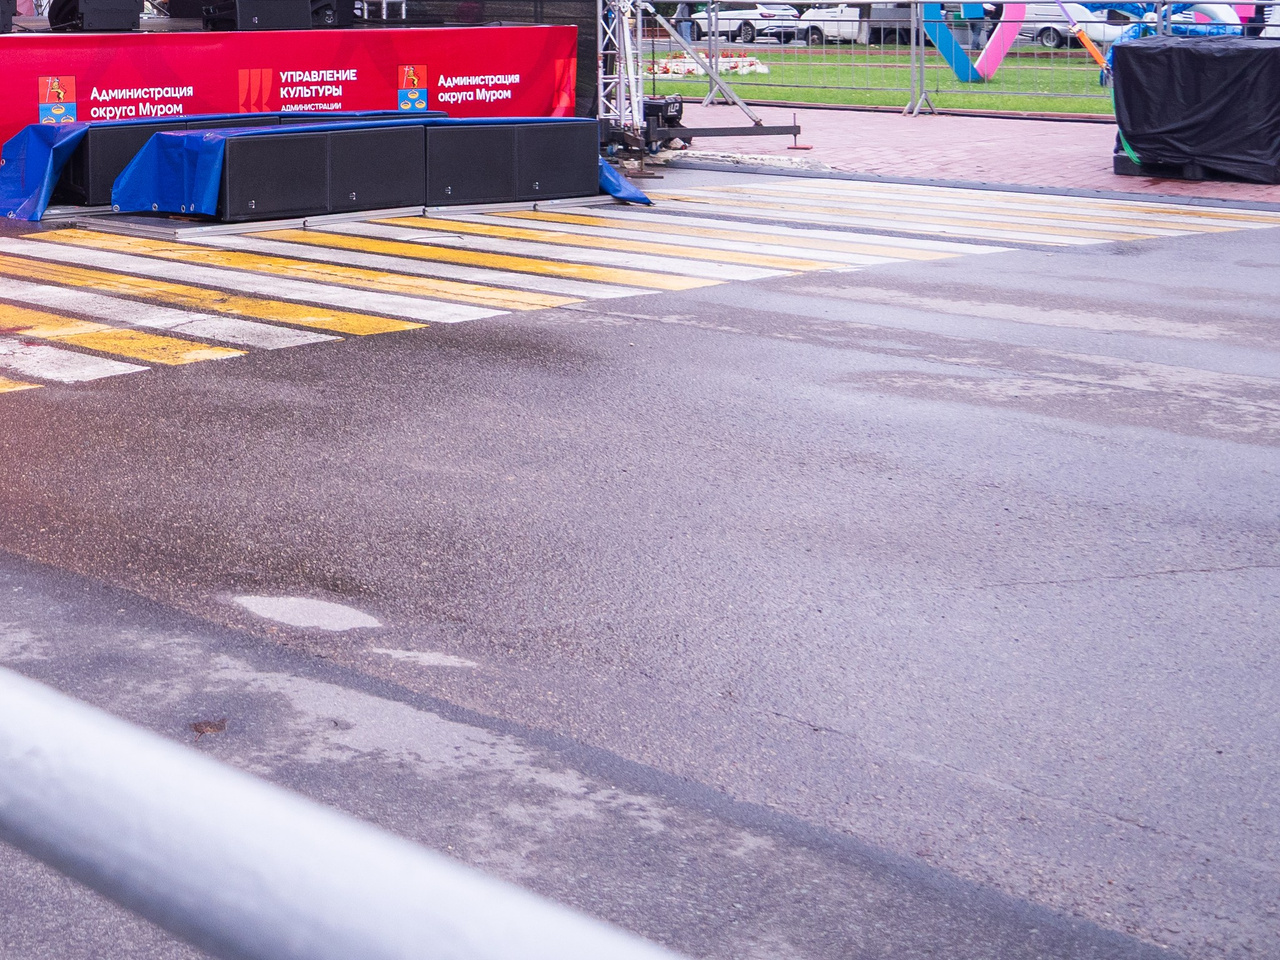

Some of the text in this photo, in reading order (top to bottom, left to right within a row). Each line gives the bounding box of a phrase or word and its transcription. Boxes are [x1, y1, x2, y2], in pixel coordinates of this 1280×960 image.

[279, 69, 358, 83] УПРАВЛЕНИЕ
[438, 73, 520, 88] Администрация
[90, 86, 194, 102] Администрация
[280, 85, 343, 99] КУЛЬТУРЫ
[438, 88, 511, 104] округа Муром
[90, 102, 183, 120] округа Муром
[281, 103, 342, 112] АДМИНИСТРАЦИИ
